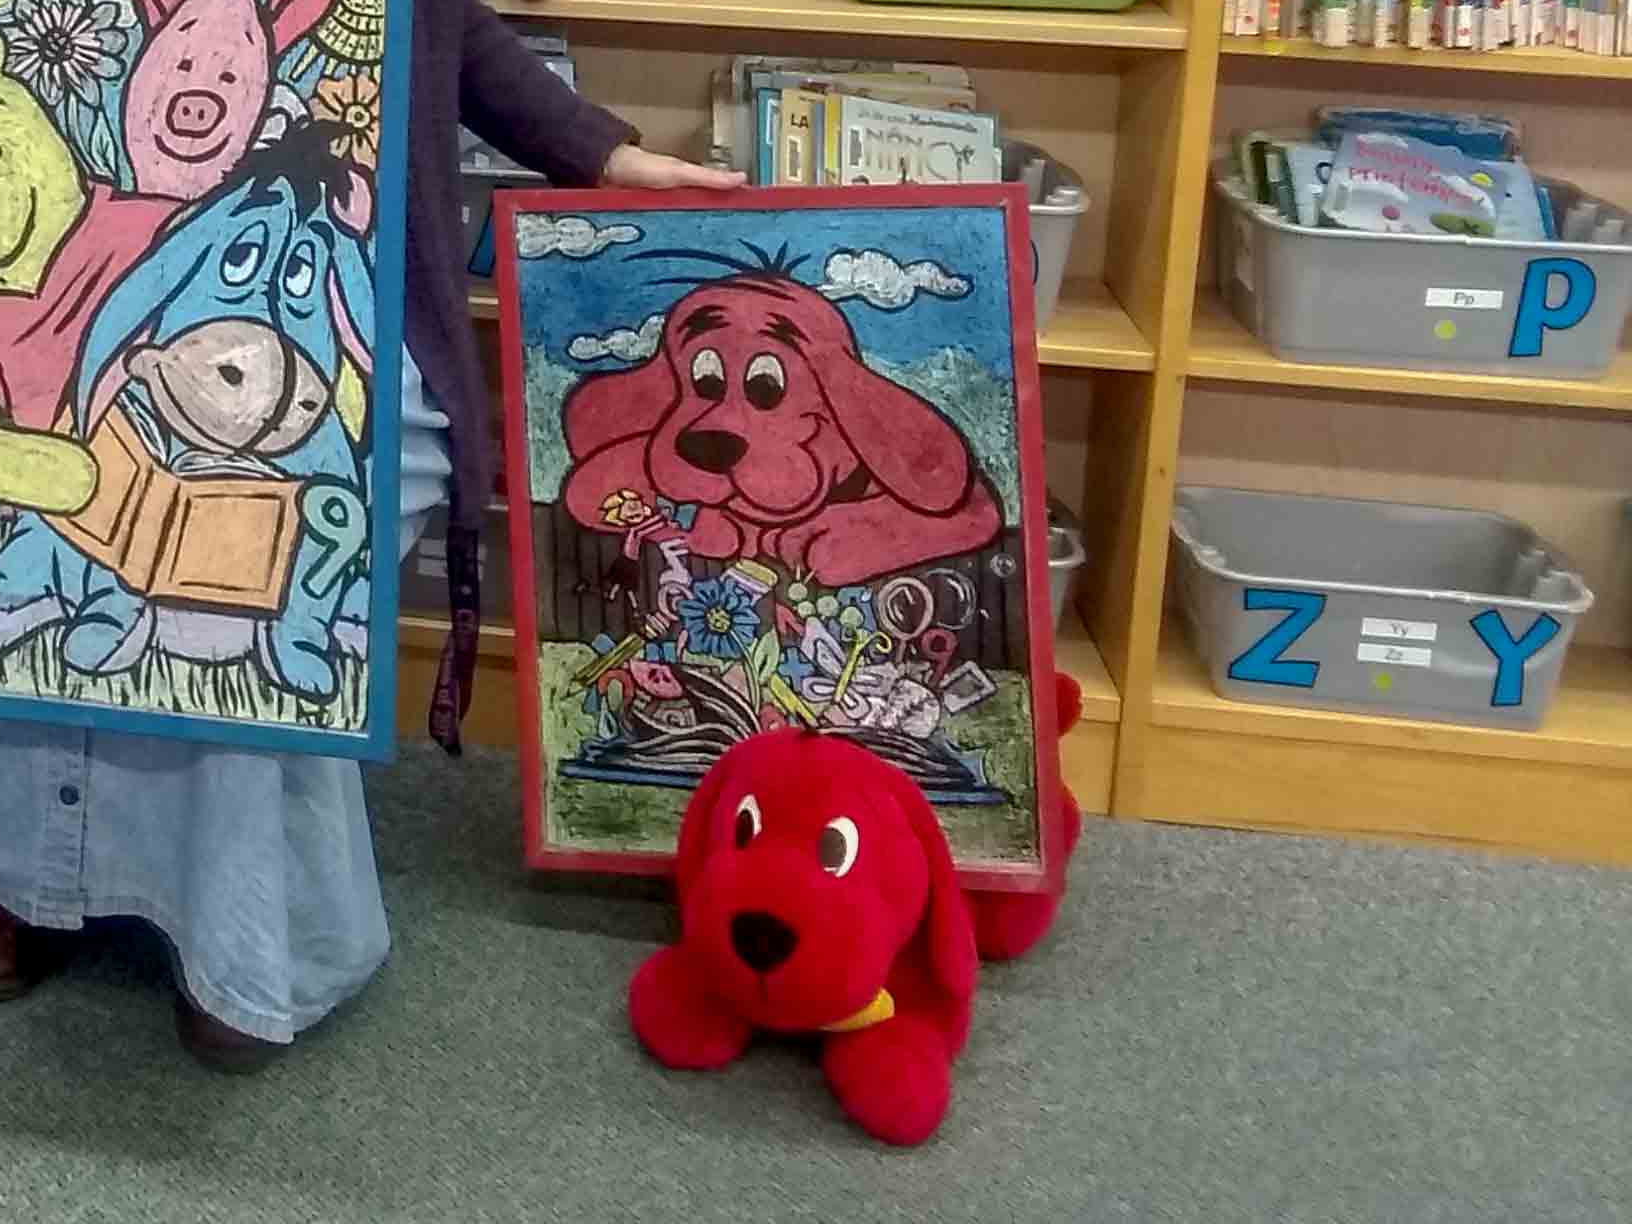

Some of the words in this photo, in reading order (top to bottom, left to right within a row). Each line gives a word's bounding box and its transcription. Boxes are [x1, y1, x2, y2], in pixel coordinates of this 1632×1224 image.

[790, 113, 809, 130] LA
[1453, 292, 1476, 306] Pp
[1508, 256, 1598, 359] P
[1227, 587, 1329, 688] Z
[1468, 607, 1562, 707] Y
